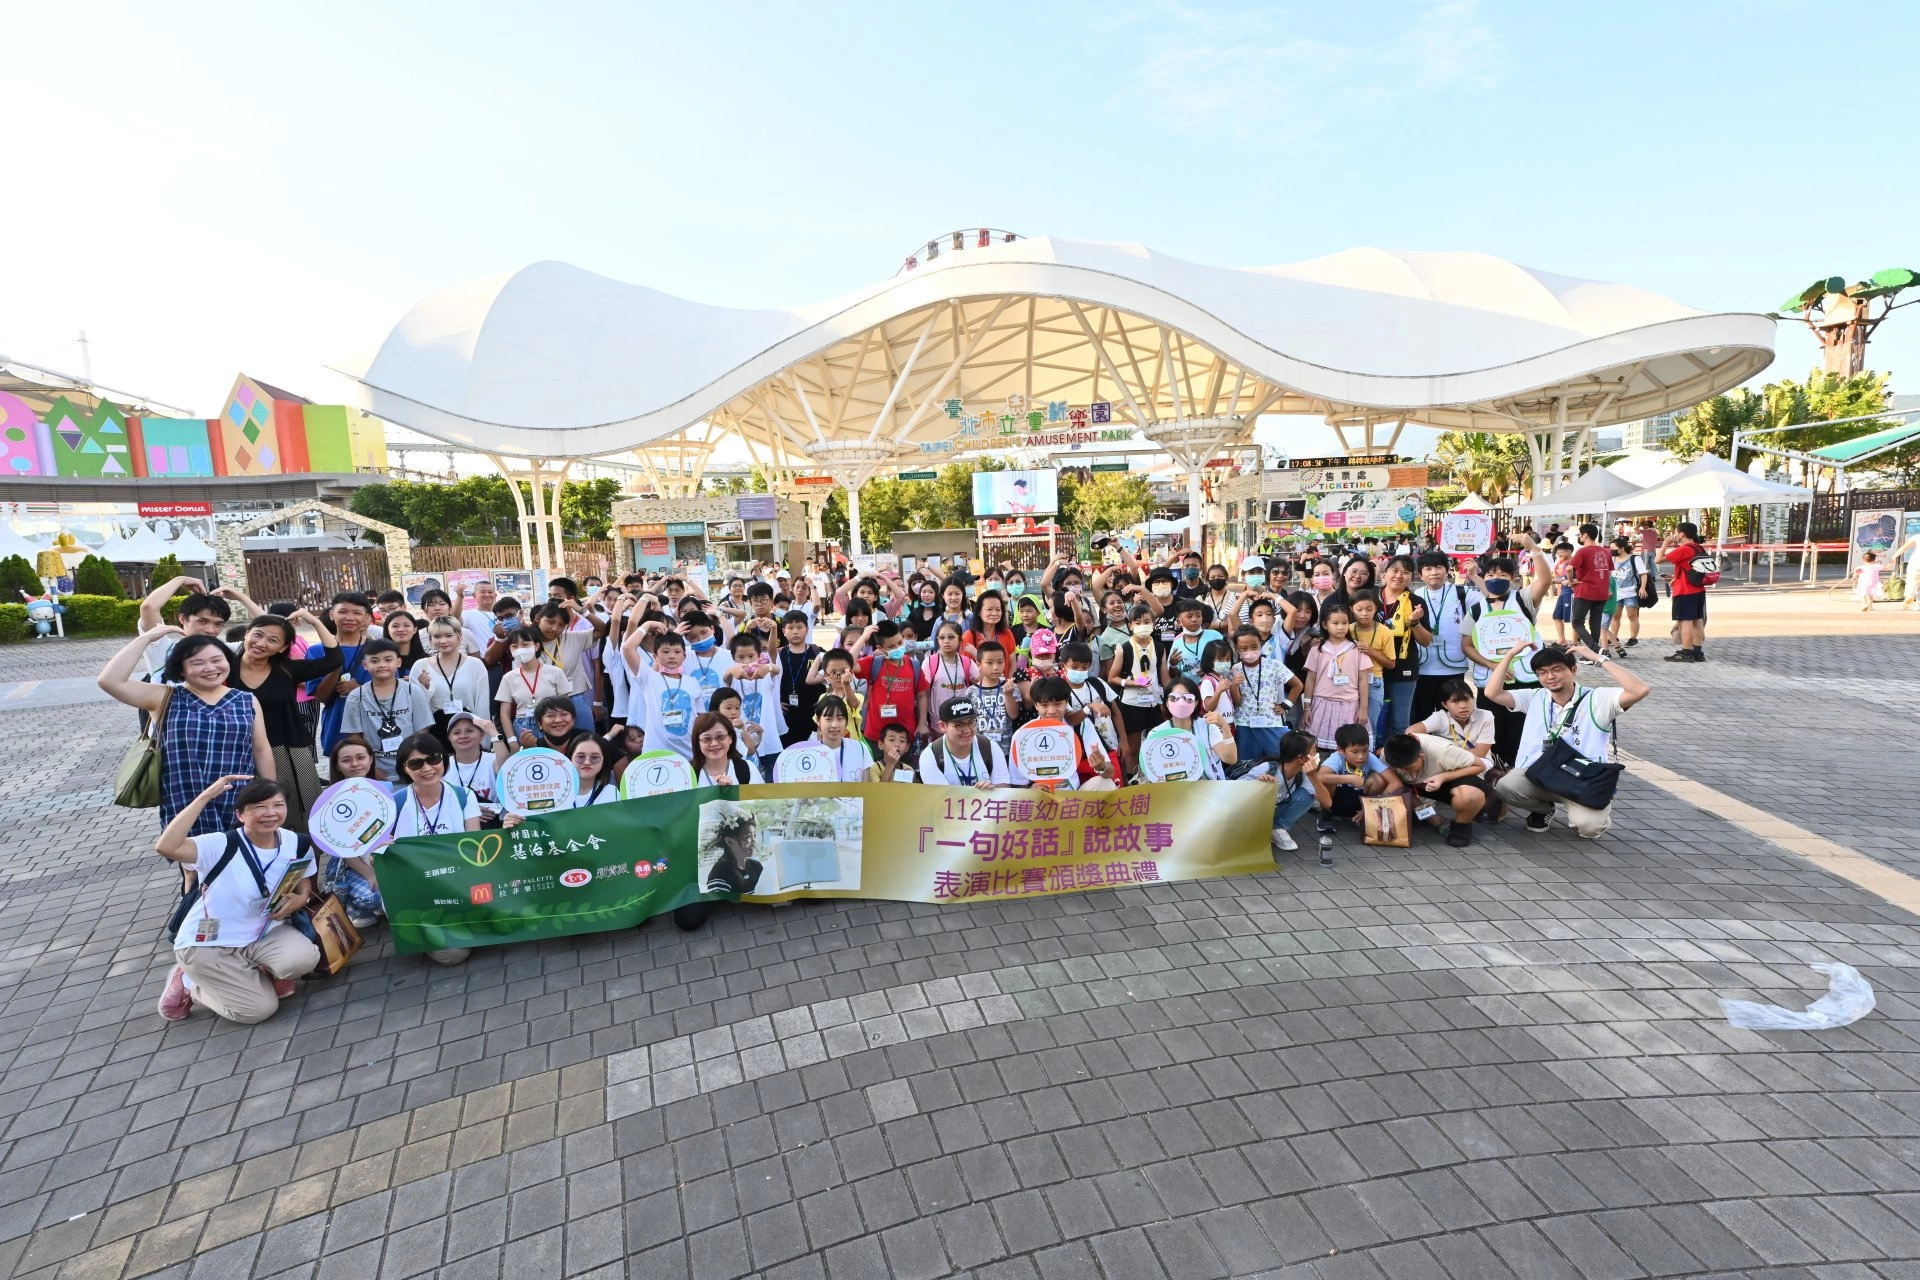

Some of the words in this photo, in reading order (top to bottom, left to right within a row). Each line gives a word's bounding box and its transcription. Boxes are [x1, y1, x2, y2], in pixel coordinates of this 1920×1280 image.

[944, 394, 1111, 436] 臺北市立兒童新樂園
[919, 442, 953, 454] TAIPEI
[954, 437, 1024, 451] CHILDREN'S
[1026, 431, 1098, 447] AMUSEMENT
[1101, 429, 1133, 442] PARK
[1325, 470, 1367, 482] 售票處
[1464, 519, 1470, 530] 1
[1498, 622, 1507, 634] 2
[978, 715, 1006, 731] DAY
[1039, 735, 1049, 750] 4
[1164, 743, 1175, 757] 3
[802, 756, 811, 771] 6
[531, 764, 544, 781] 8
[653, 766, 662, 783] 7
[336, 803, 353, 818] 9
[943, 792, 1152, 824] 112年護幼苗成大樹
[511, 829, 551, 839] 財團法人
[918, 822, 1174, 862] 『一句好話』說故事
[934, 860, 1163, 898] 表演比賽頒獎典禮
